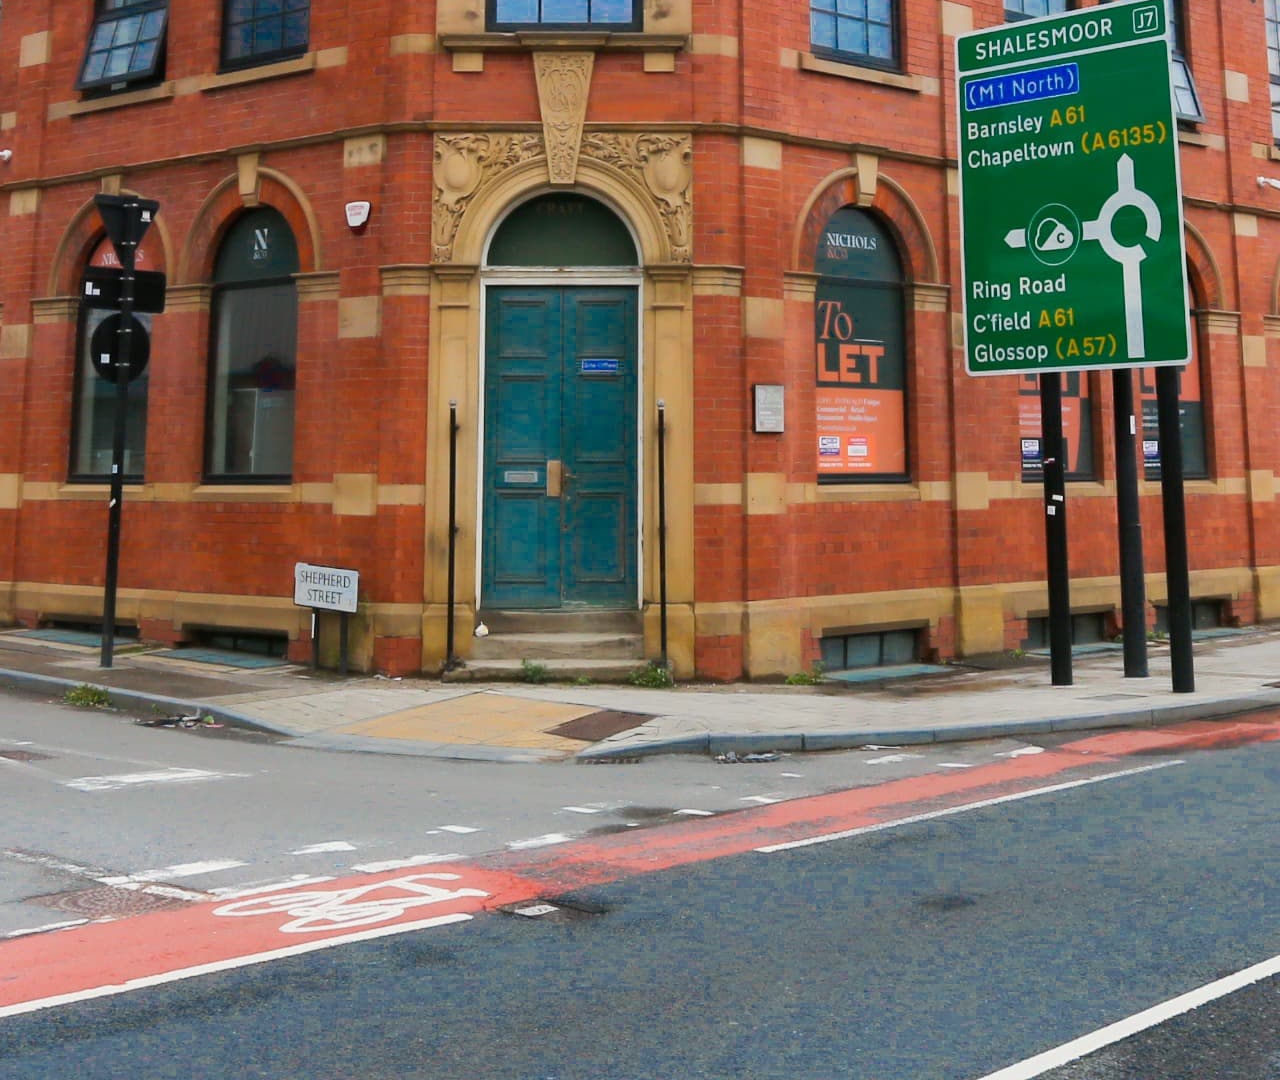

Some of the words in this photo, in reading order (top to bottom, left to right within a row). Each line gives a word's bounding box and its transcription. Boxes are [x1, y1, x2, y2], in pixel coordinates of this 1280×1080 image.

[975, 18, 1113, 60] SHALESMOOR
[1137, 11, 1154, 29] J7
[1013, 67, 1074, 97] North)
[967, 114, 1043, 140] Barnsley
[967, 140, 1074, 168] Chapeltown
[254, 228, 269, 250] N
[827, 232, 877, 250] NICHOLS
[972, 280, 1011, 301] Ring
[1019, 273, 1066, 296] Road
[817, 300, 853, 341] To
[973, 311, 1031, 333] C'field
[816, 342, 885, 383] LET
[974, 343, 1049, 363] Glossop
[300, 570, 351, 589] SHEPHERD
[307, 588, 343, 604] STREET
